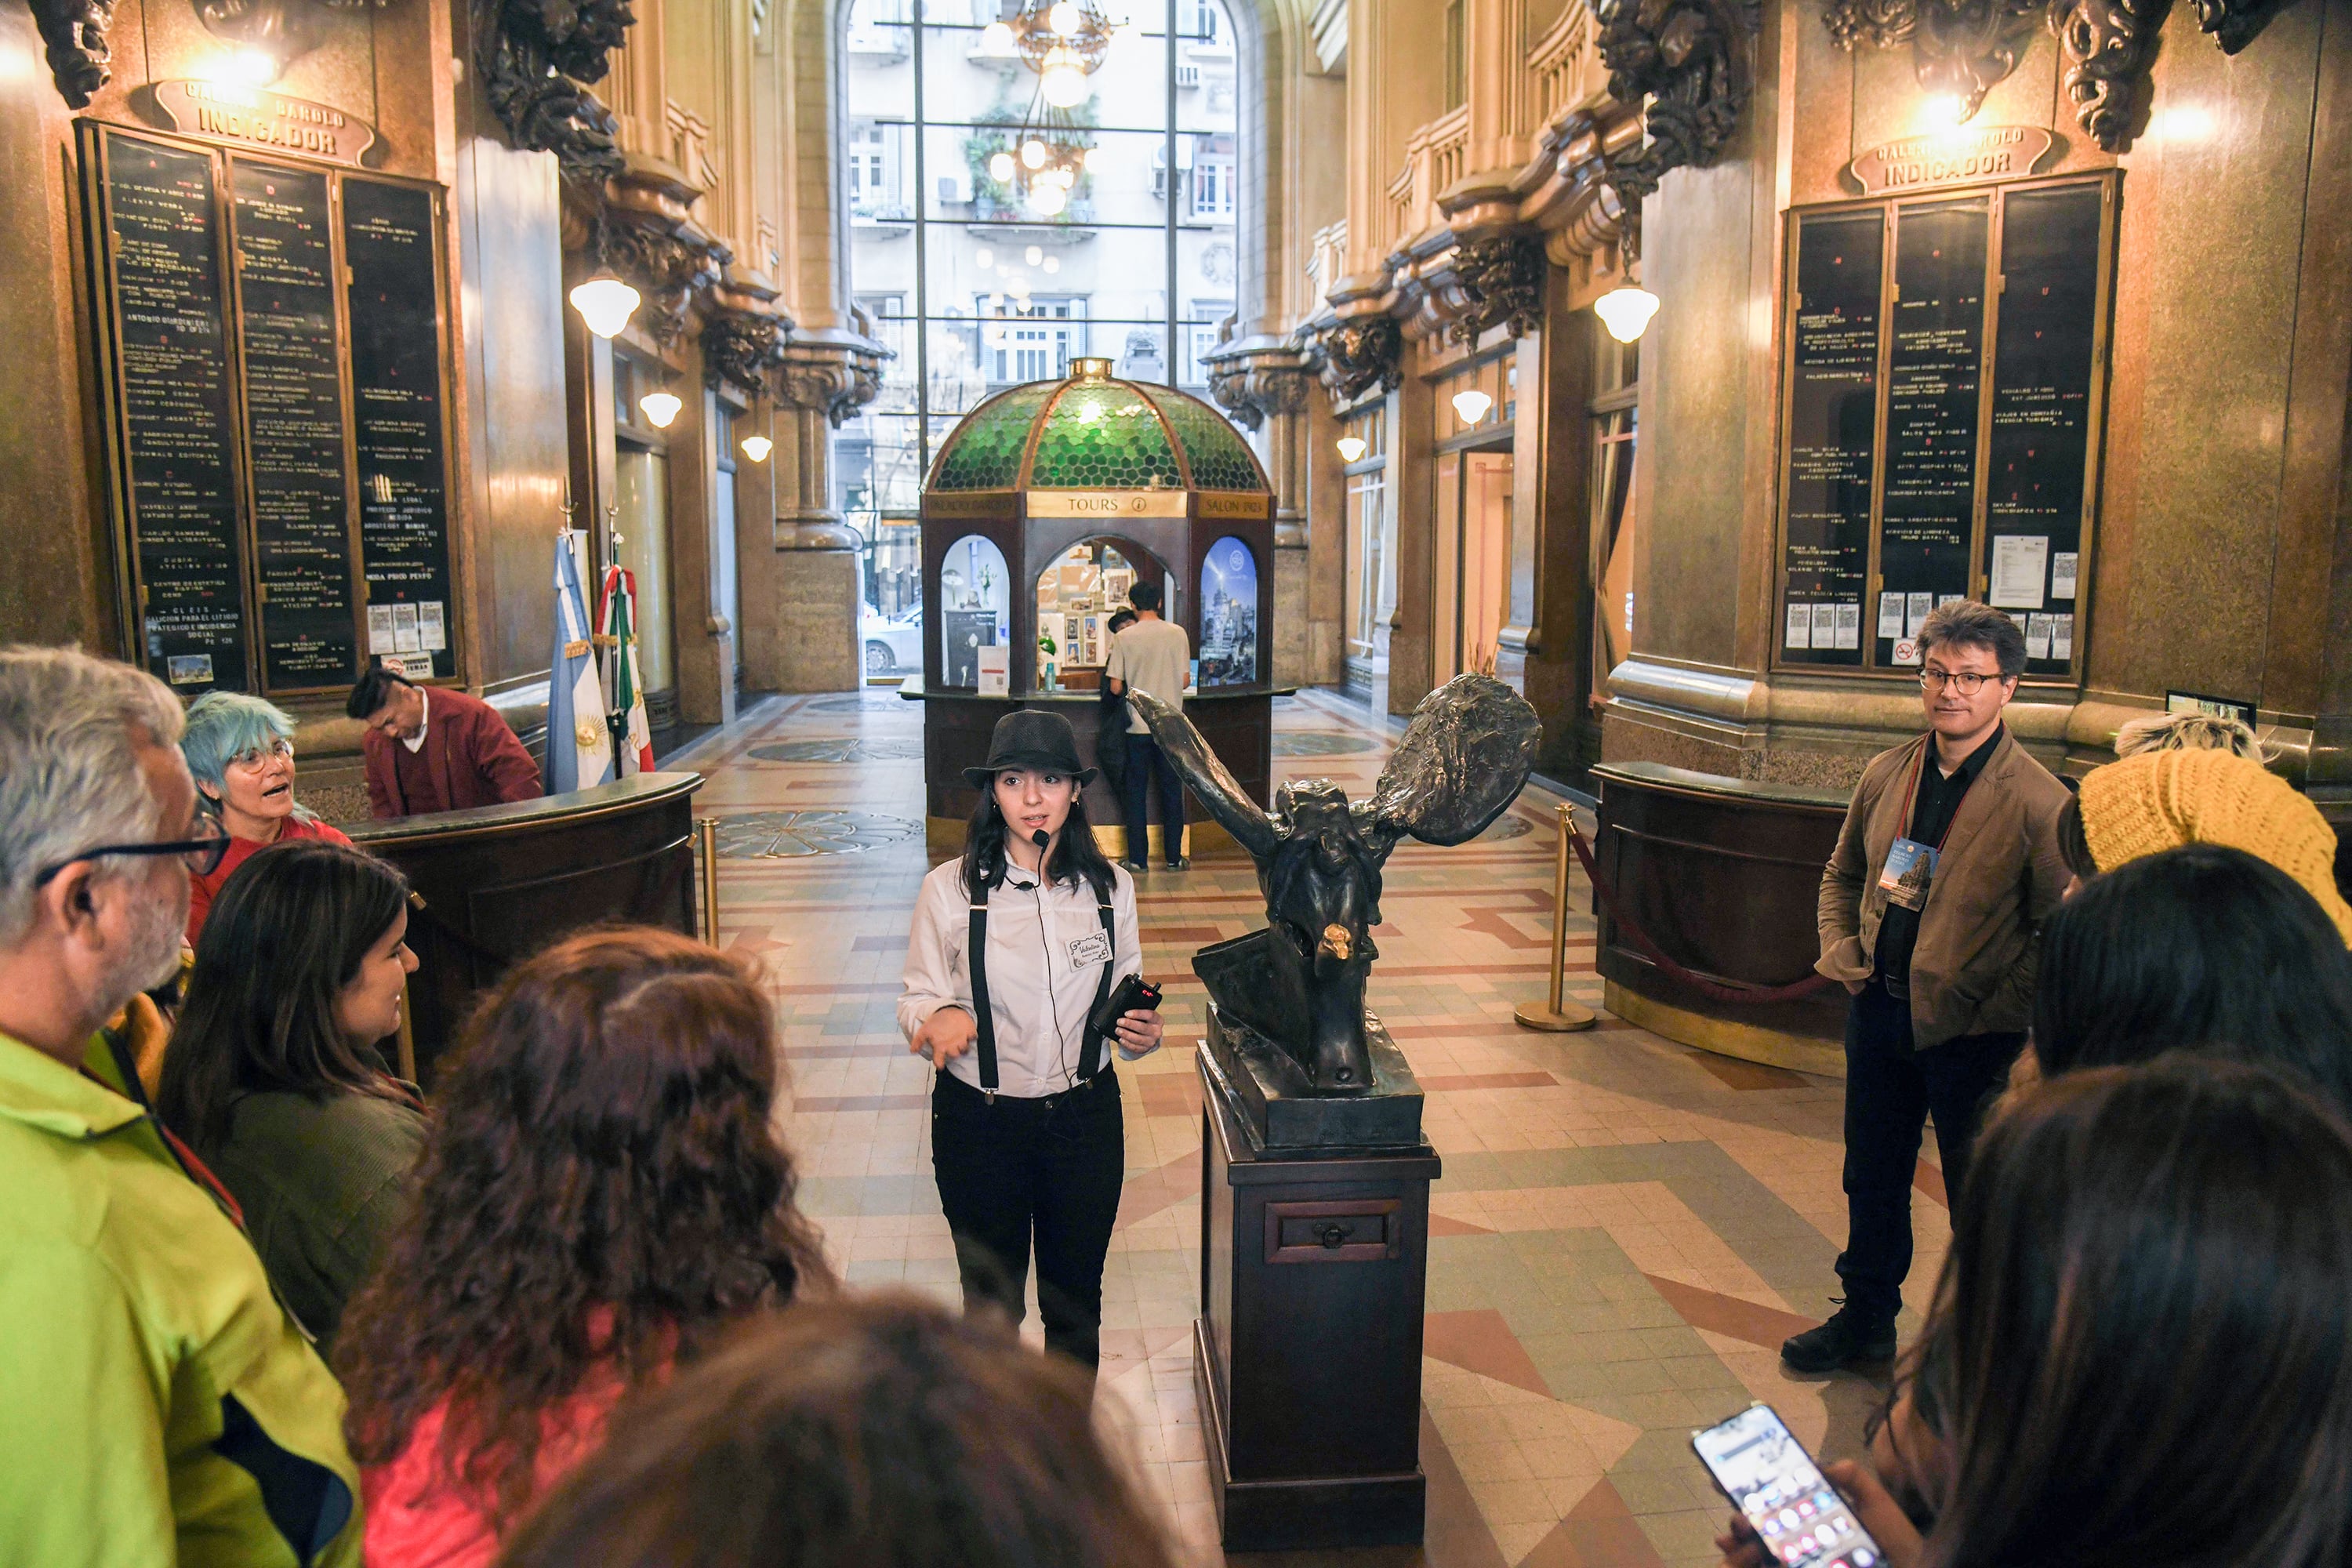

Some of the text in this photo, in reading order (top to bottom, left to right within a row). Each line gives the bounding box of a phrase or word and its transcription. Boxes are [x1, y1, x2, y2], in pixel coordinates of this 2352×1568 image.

[199, 106, 337, 154] INDICADOR
[1877, 140, 1940, 162] GALERI
[1885, 152, 2011, 187] INDICADOR
[127, 314, 160, 323] ANTONIO
[1068, 499, 1118, 510] TOURS
[1207, 498, 1239, 511] SALON
[187, 630, 215, 639] SOCIAL
